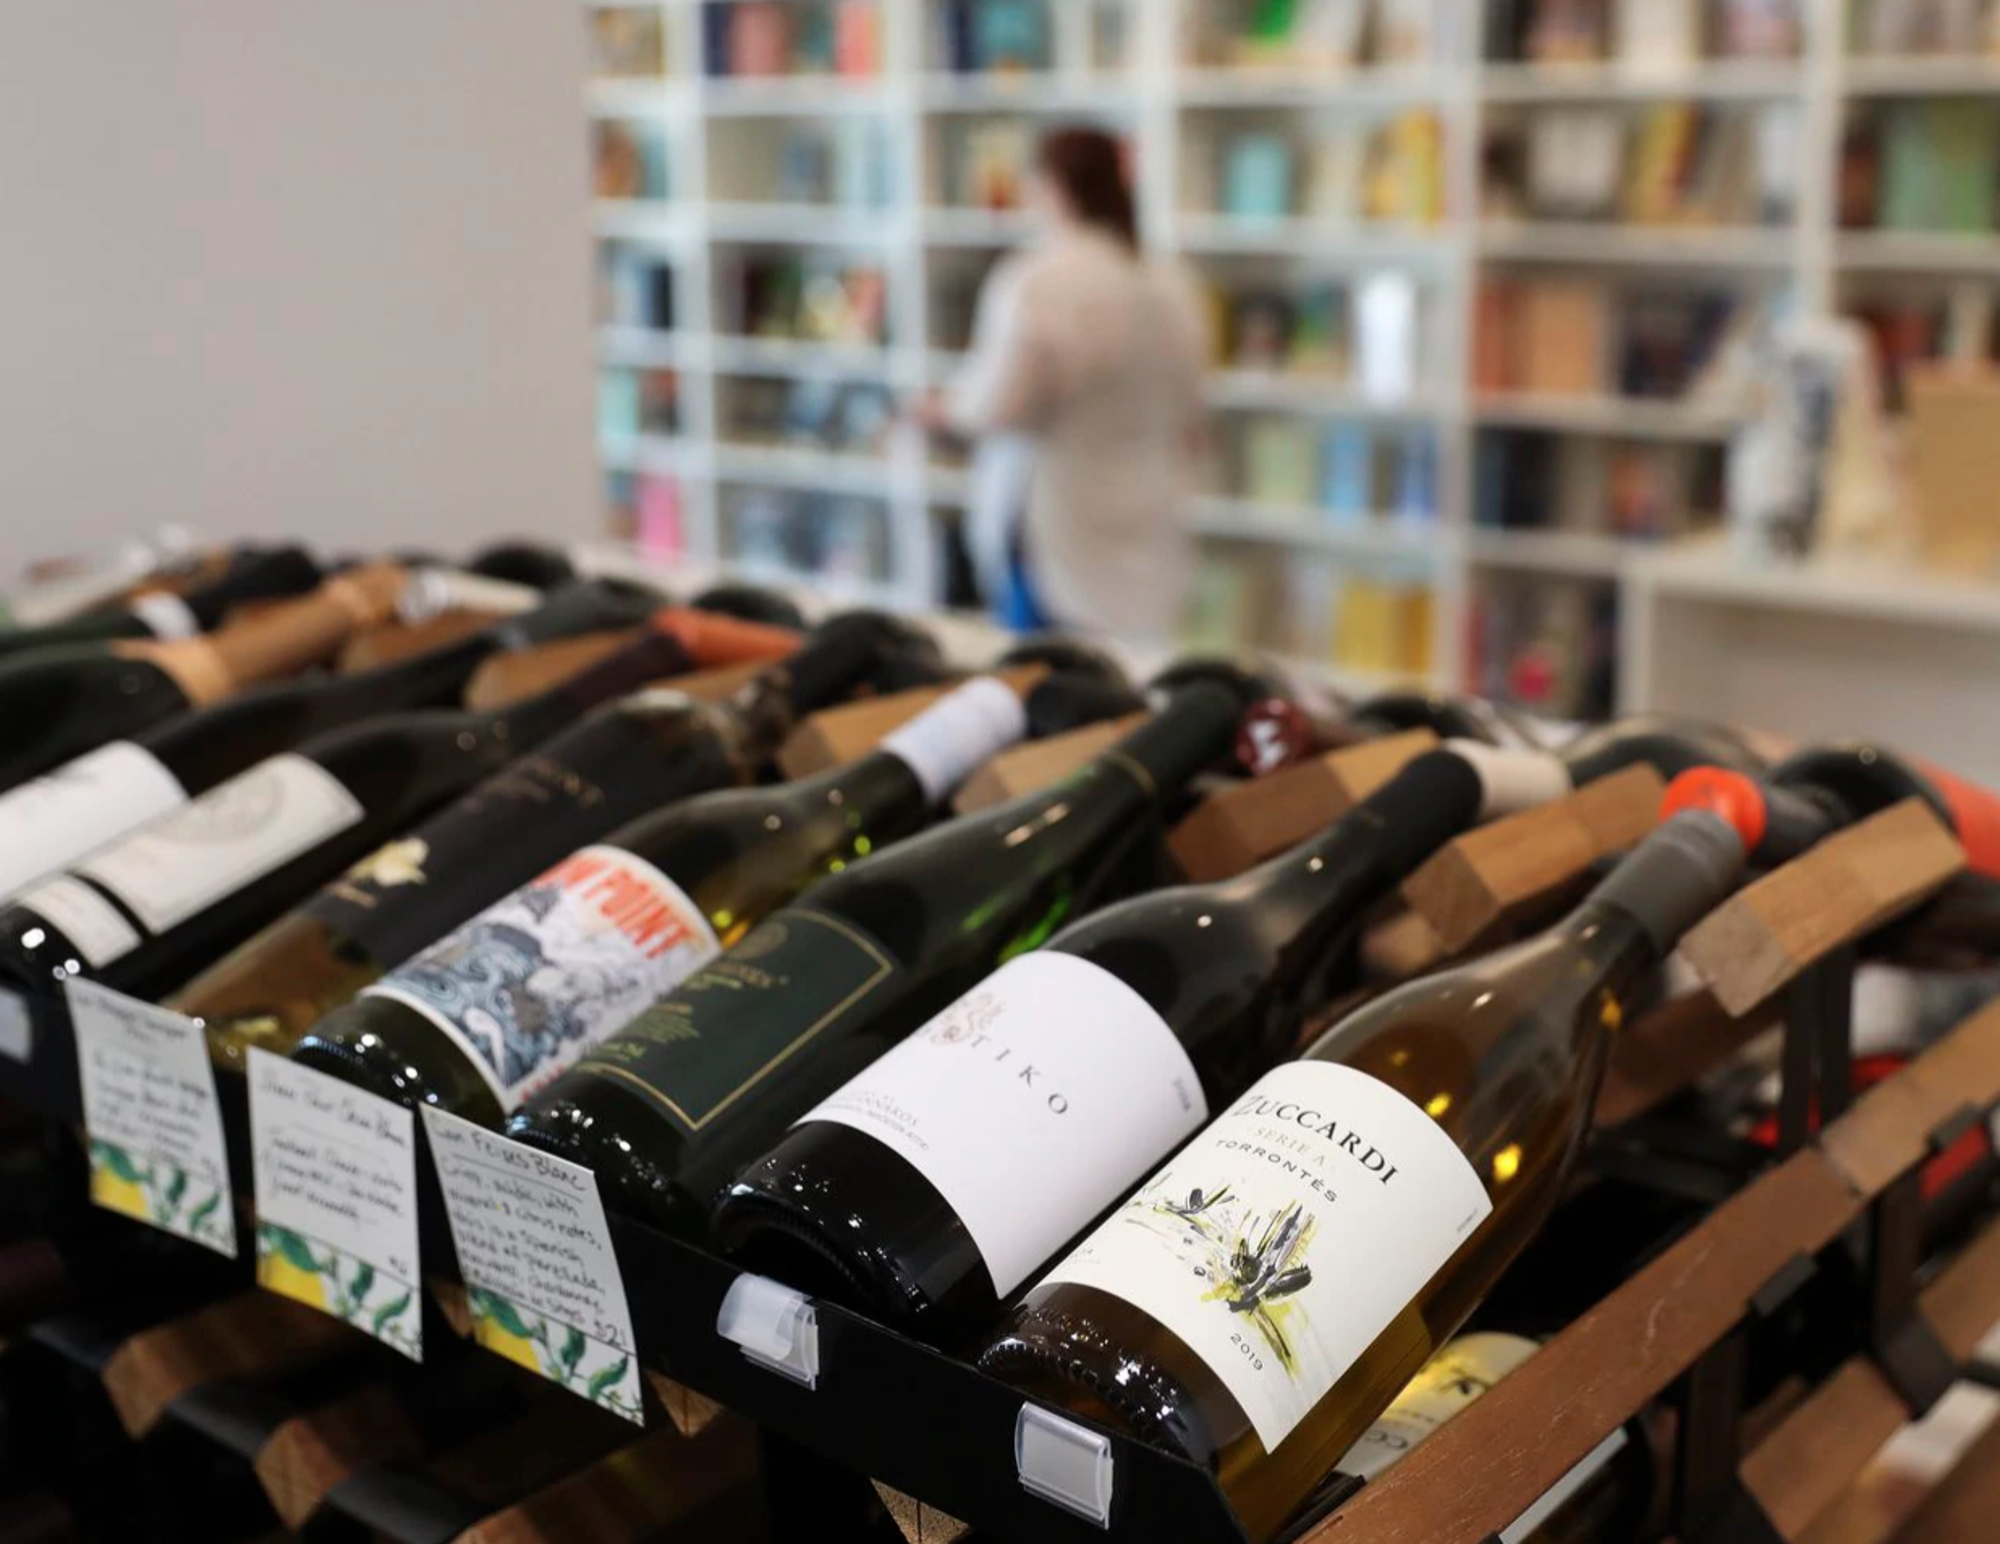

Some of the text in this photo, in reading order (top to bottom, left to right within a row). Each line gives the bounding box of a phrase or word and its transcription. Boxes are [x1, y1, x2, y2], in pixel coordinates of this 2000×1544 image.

[1231, 1094, 1399, 1185] ZUCCARDI
[1254, 1127, 1311, 1153] SERIE
[1215, 1138, 1338, 1202] TORRONTÉS
[1230, 1333, 1263, 1371] 2019
